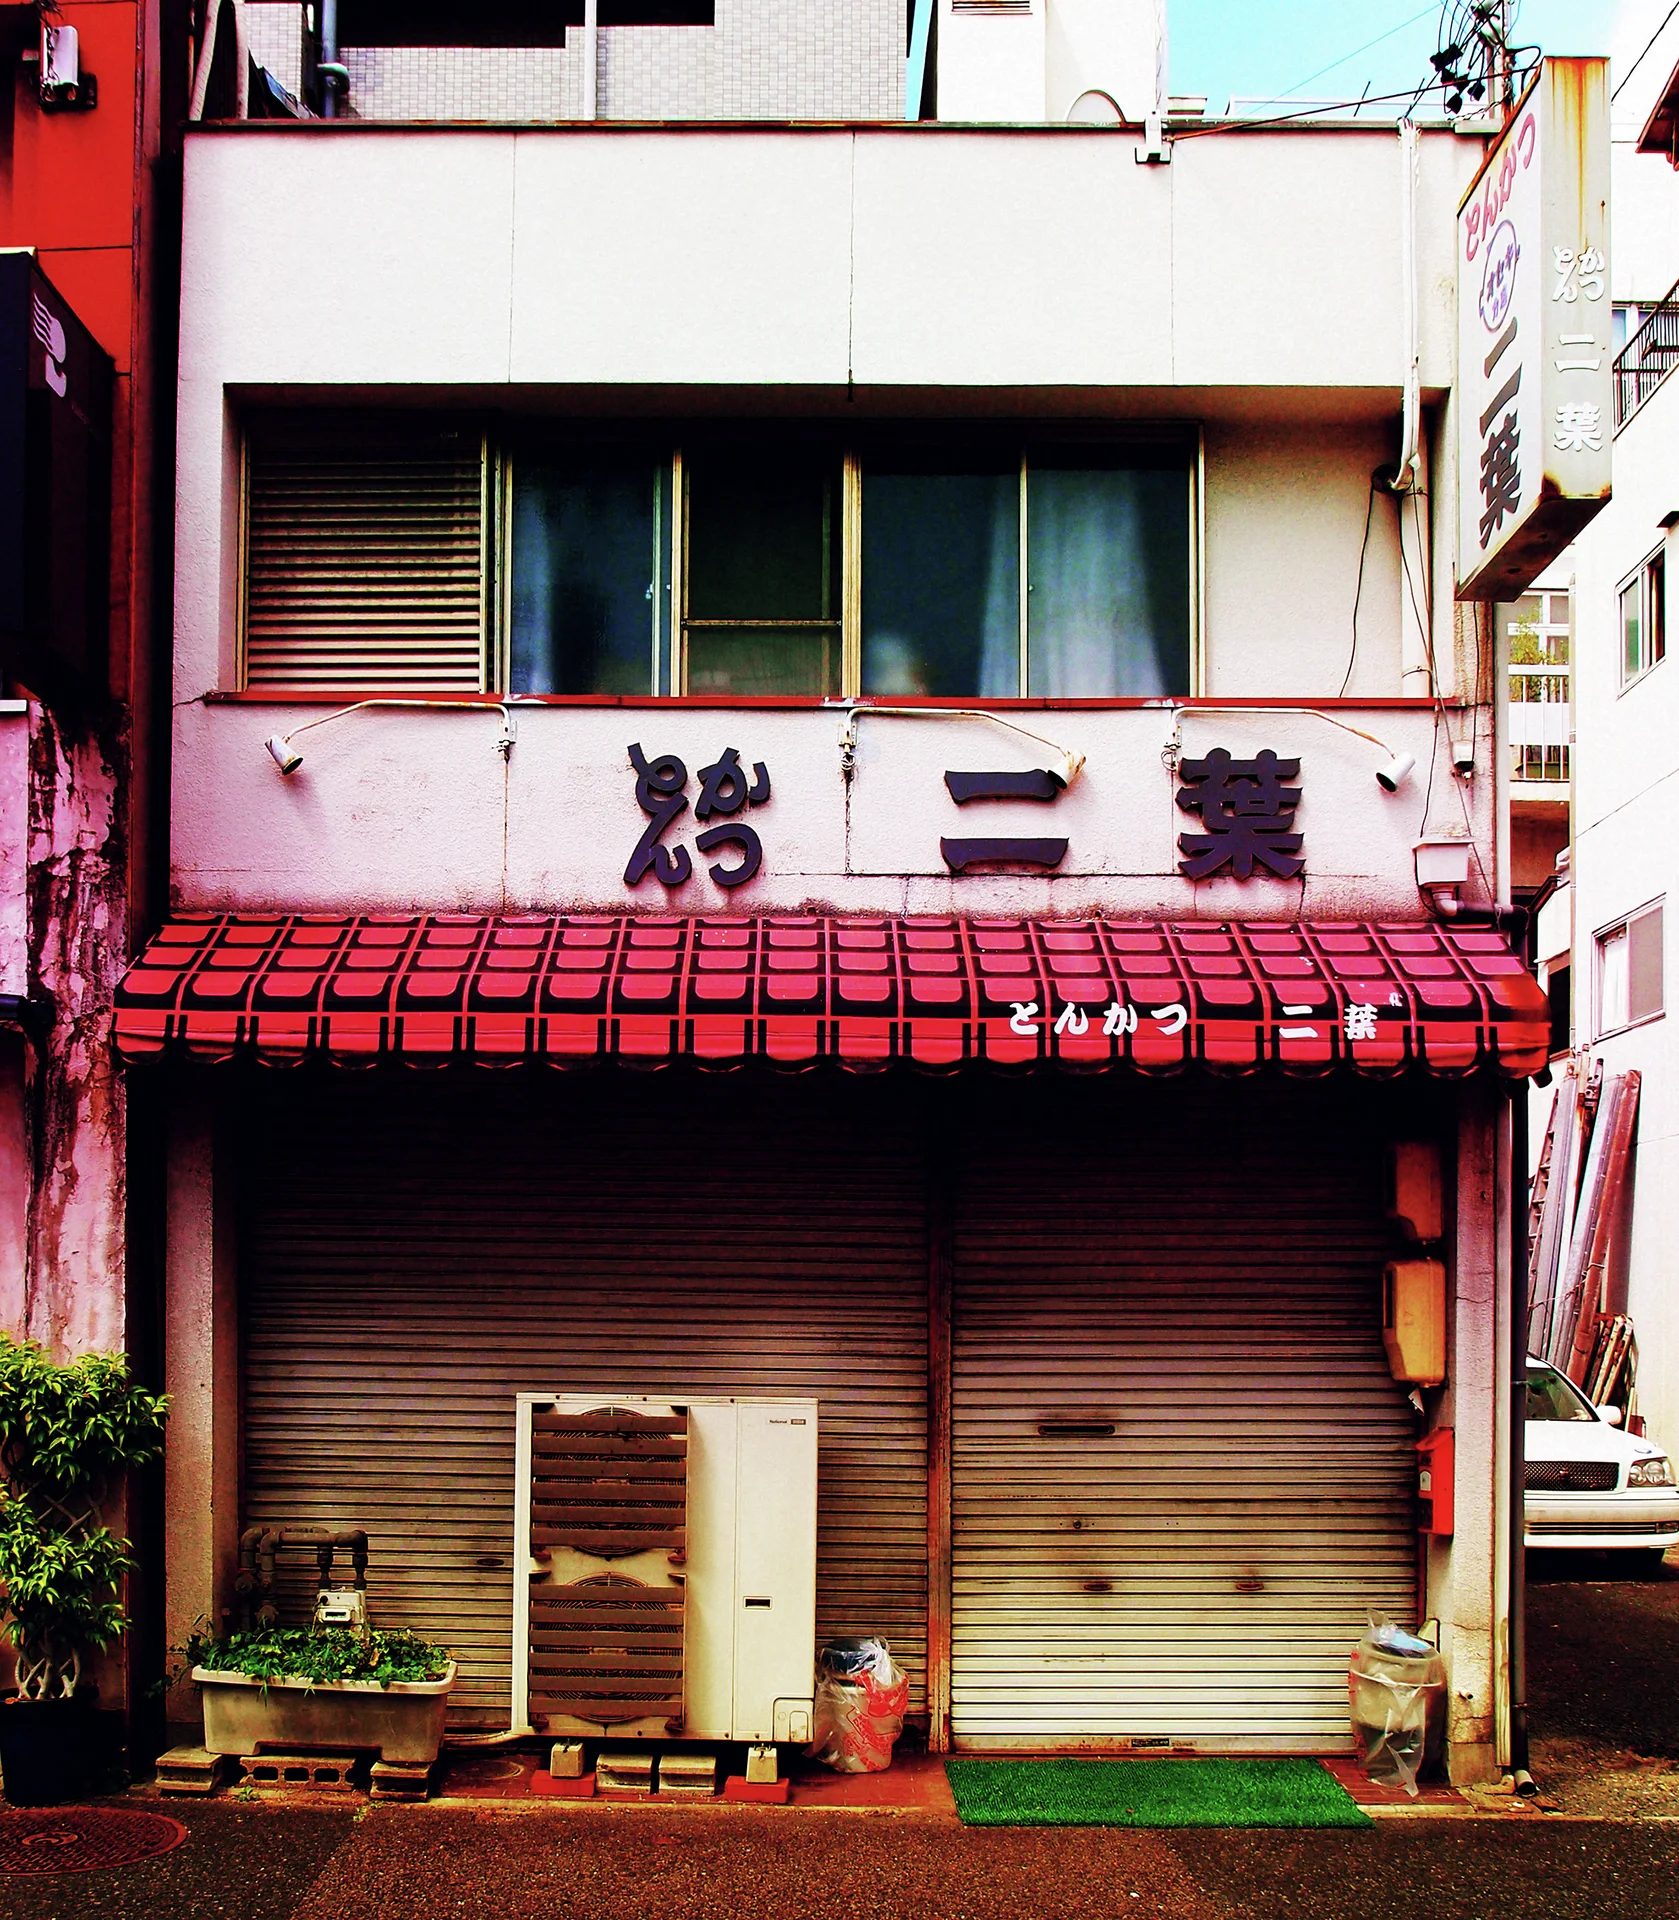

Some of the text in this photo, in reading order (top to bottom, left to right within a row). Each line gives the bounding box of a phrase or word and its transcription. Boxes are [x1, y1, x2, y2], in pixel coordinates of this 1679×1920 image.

[1465, 112, 1536, 262] とんかつ
[1479, 316, 1523, 550] 二葉
[1553, 333, 1604, 452] 二葉
[939, 747, 1306, 882] 二葉
[1009, 1001, 1379, 1040] とんかつ 二葉
